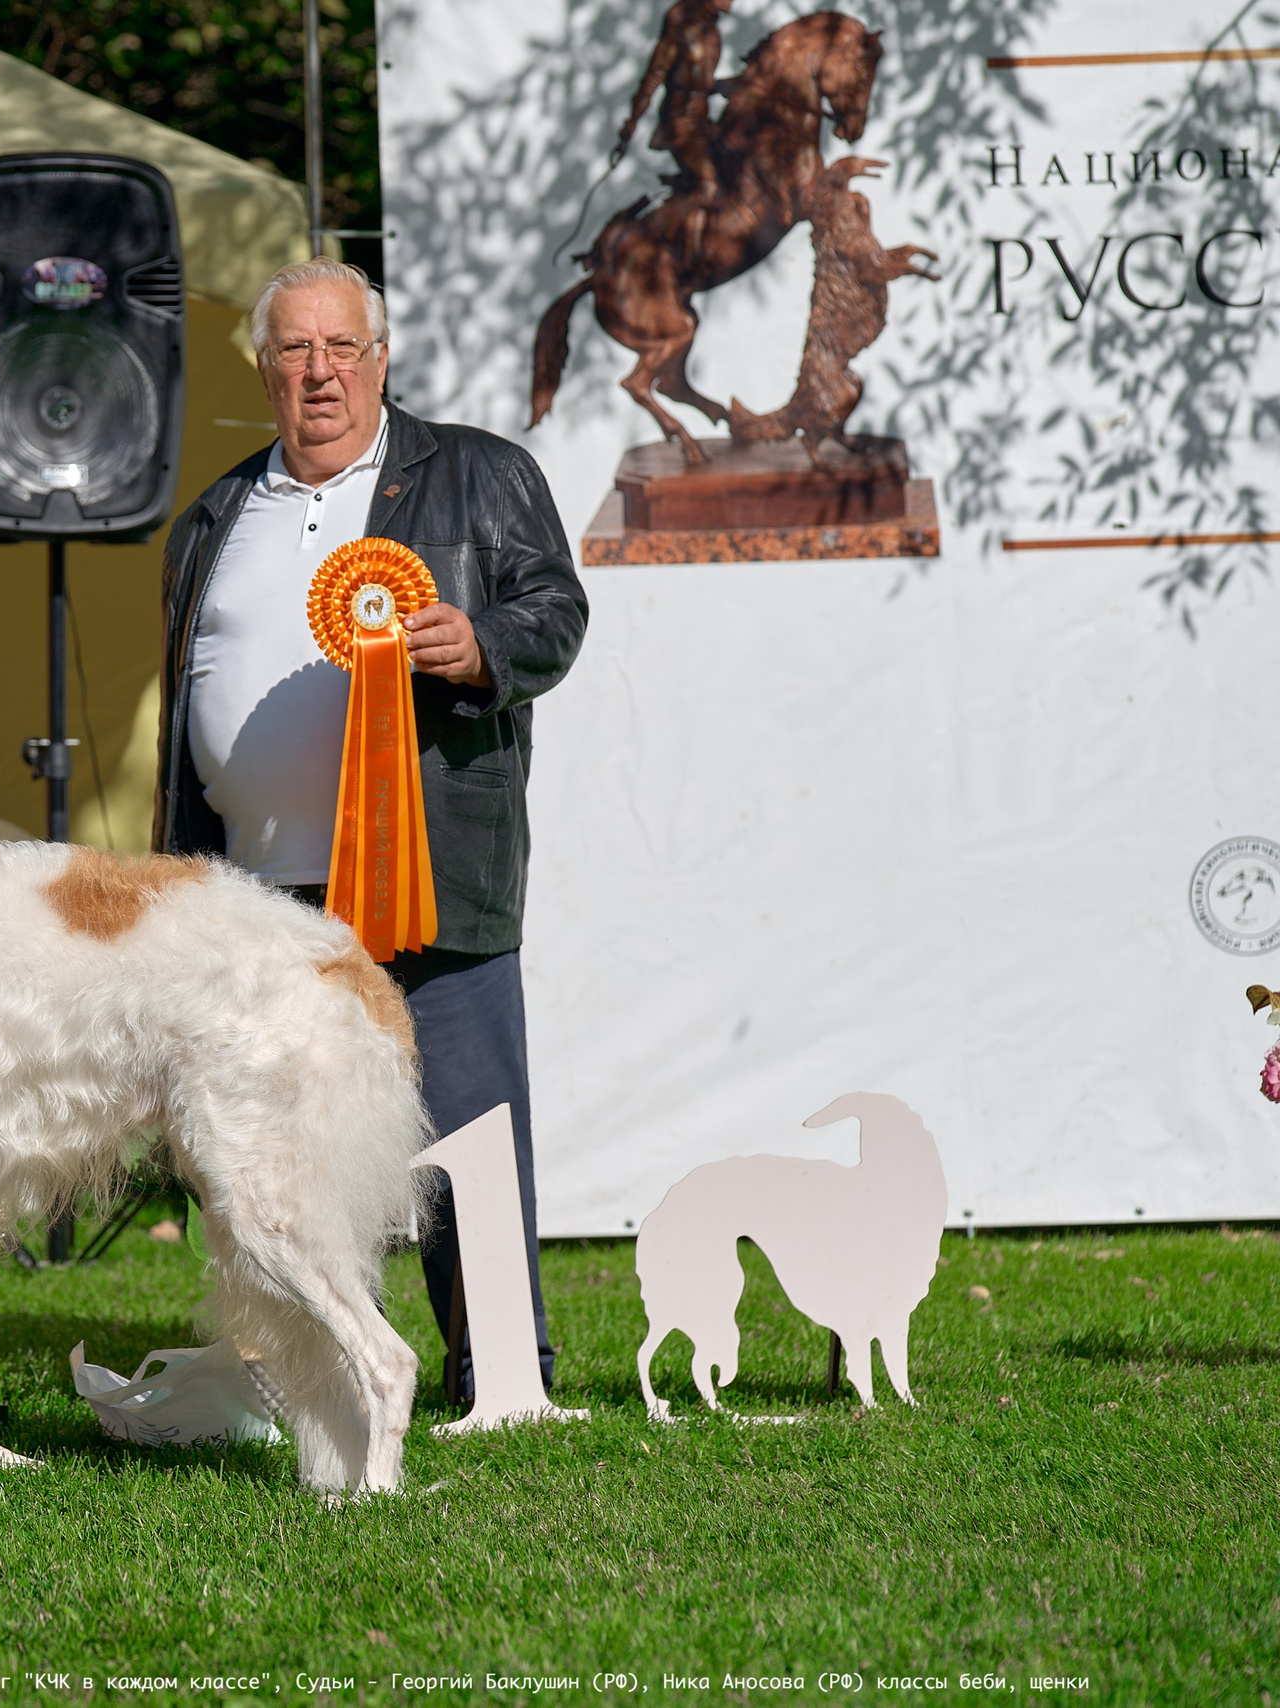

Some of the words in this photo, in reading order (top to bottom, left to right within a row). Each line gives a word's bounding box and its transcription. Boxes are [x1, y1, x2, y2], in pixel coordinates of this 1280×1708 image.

[983, 229, 1280, 321] РУСС
[375, 777, 392, 852] ЛУЧШИЙ
[374, 857, 389, 922] КОБЕЛЬ
